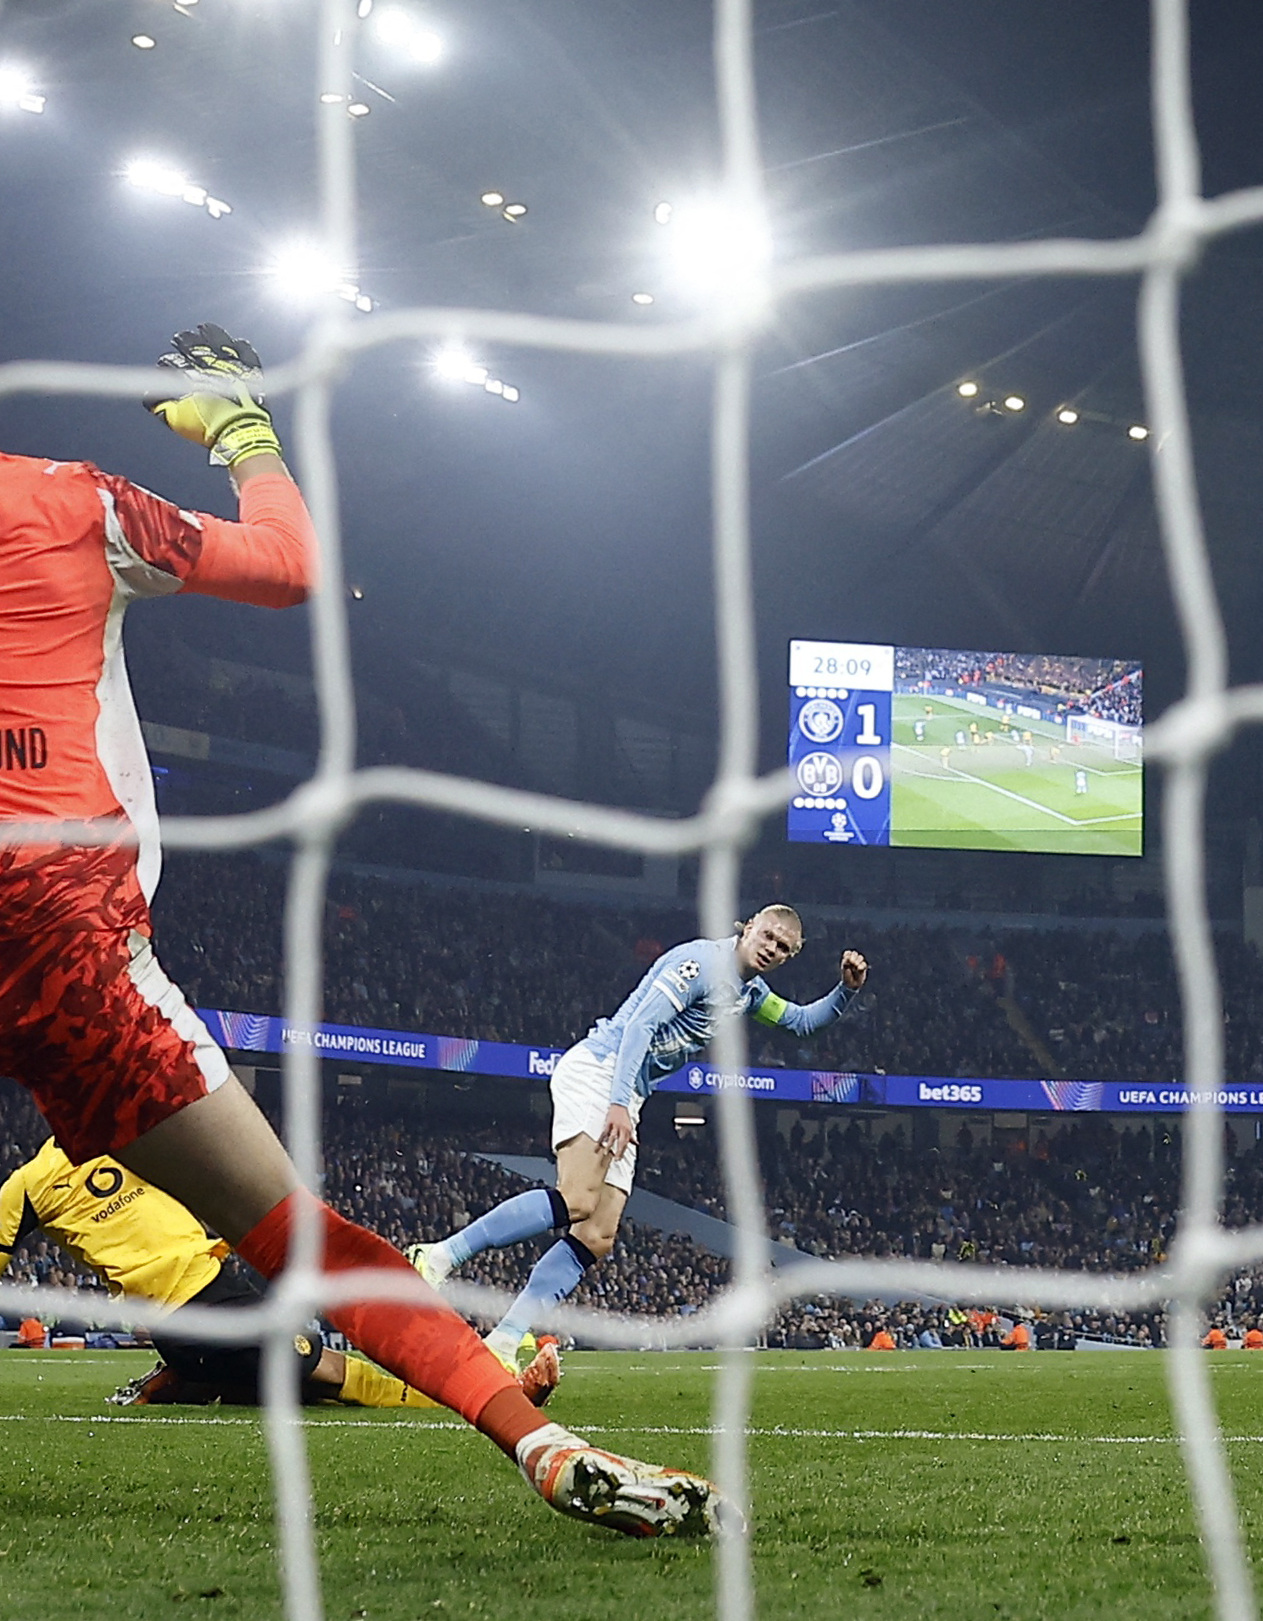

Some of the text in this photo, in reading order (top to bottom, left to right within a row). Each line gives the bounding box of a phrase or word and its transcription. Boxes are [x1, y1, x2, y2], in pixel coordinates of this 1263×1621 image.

[813, 656, 872, 677] 28:09
[855, 703, 882, 746] 1
[803, 756, 838, 785] BVB
[850, 755, 884, 800] 0
[314, 1032, 381, 1054] CHAMPIONS
[382, 1040, 426, 1059] LEAGUE
[705, 1072, 775, 1091] crypto.com
[919, 1081, 983, 1103] bet365
[1119, 1090, 1157, 1104] UEFA
[1159, 1090, 1247, 1105] CHAMPIONS
[90, 1186, 146, 1223] vodafone
